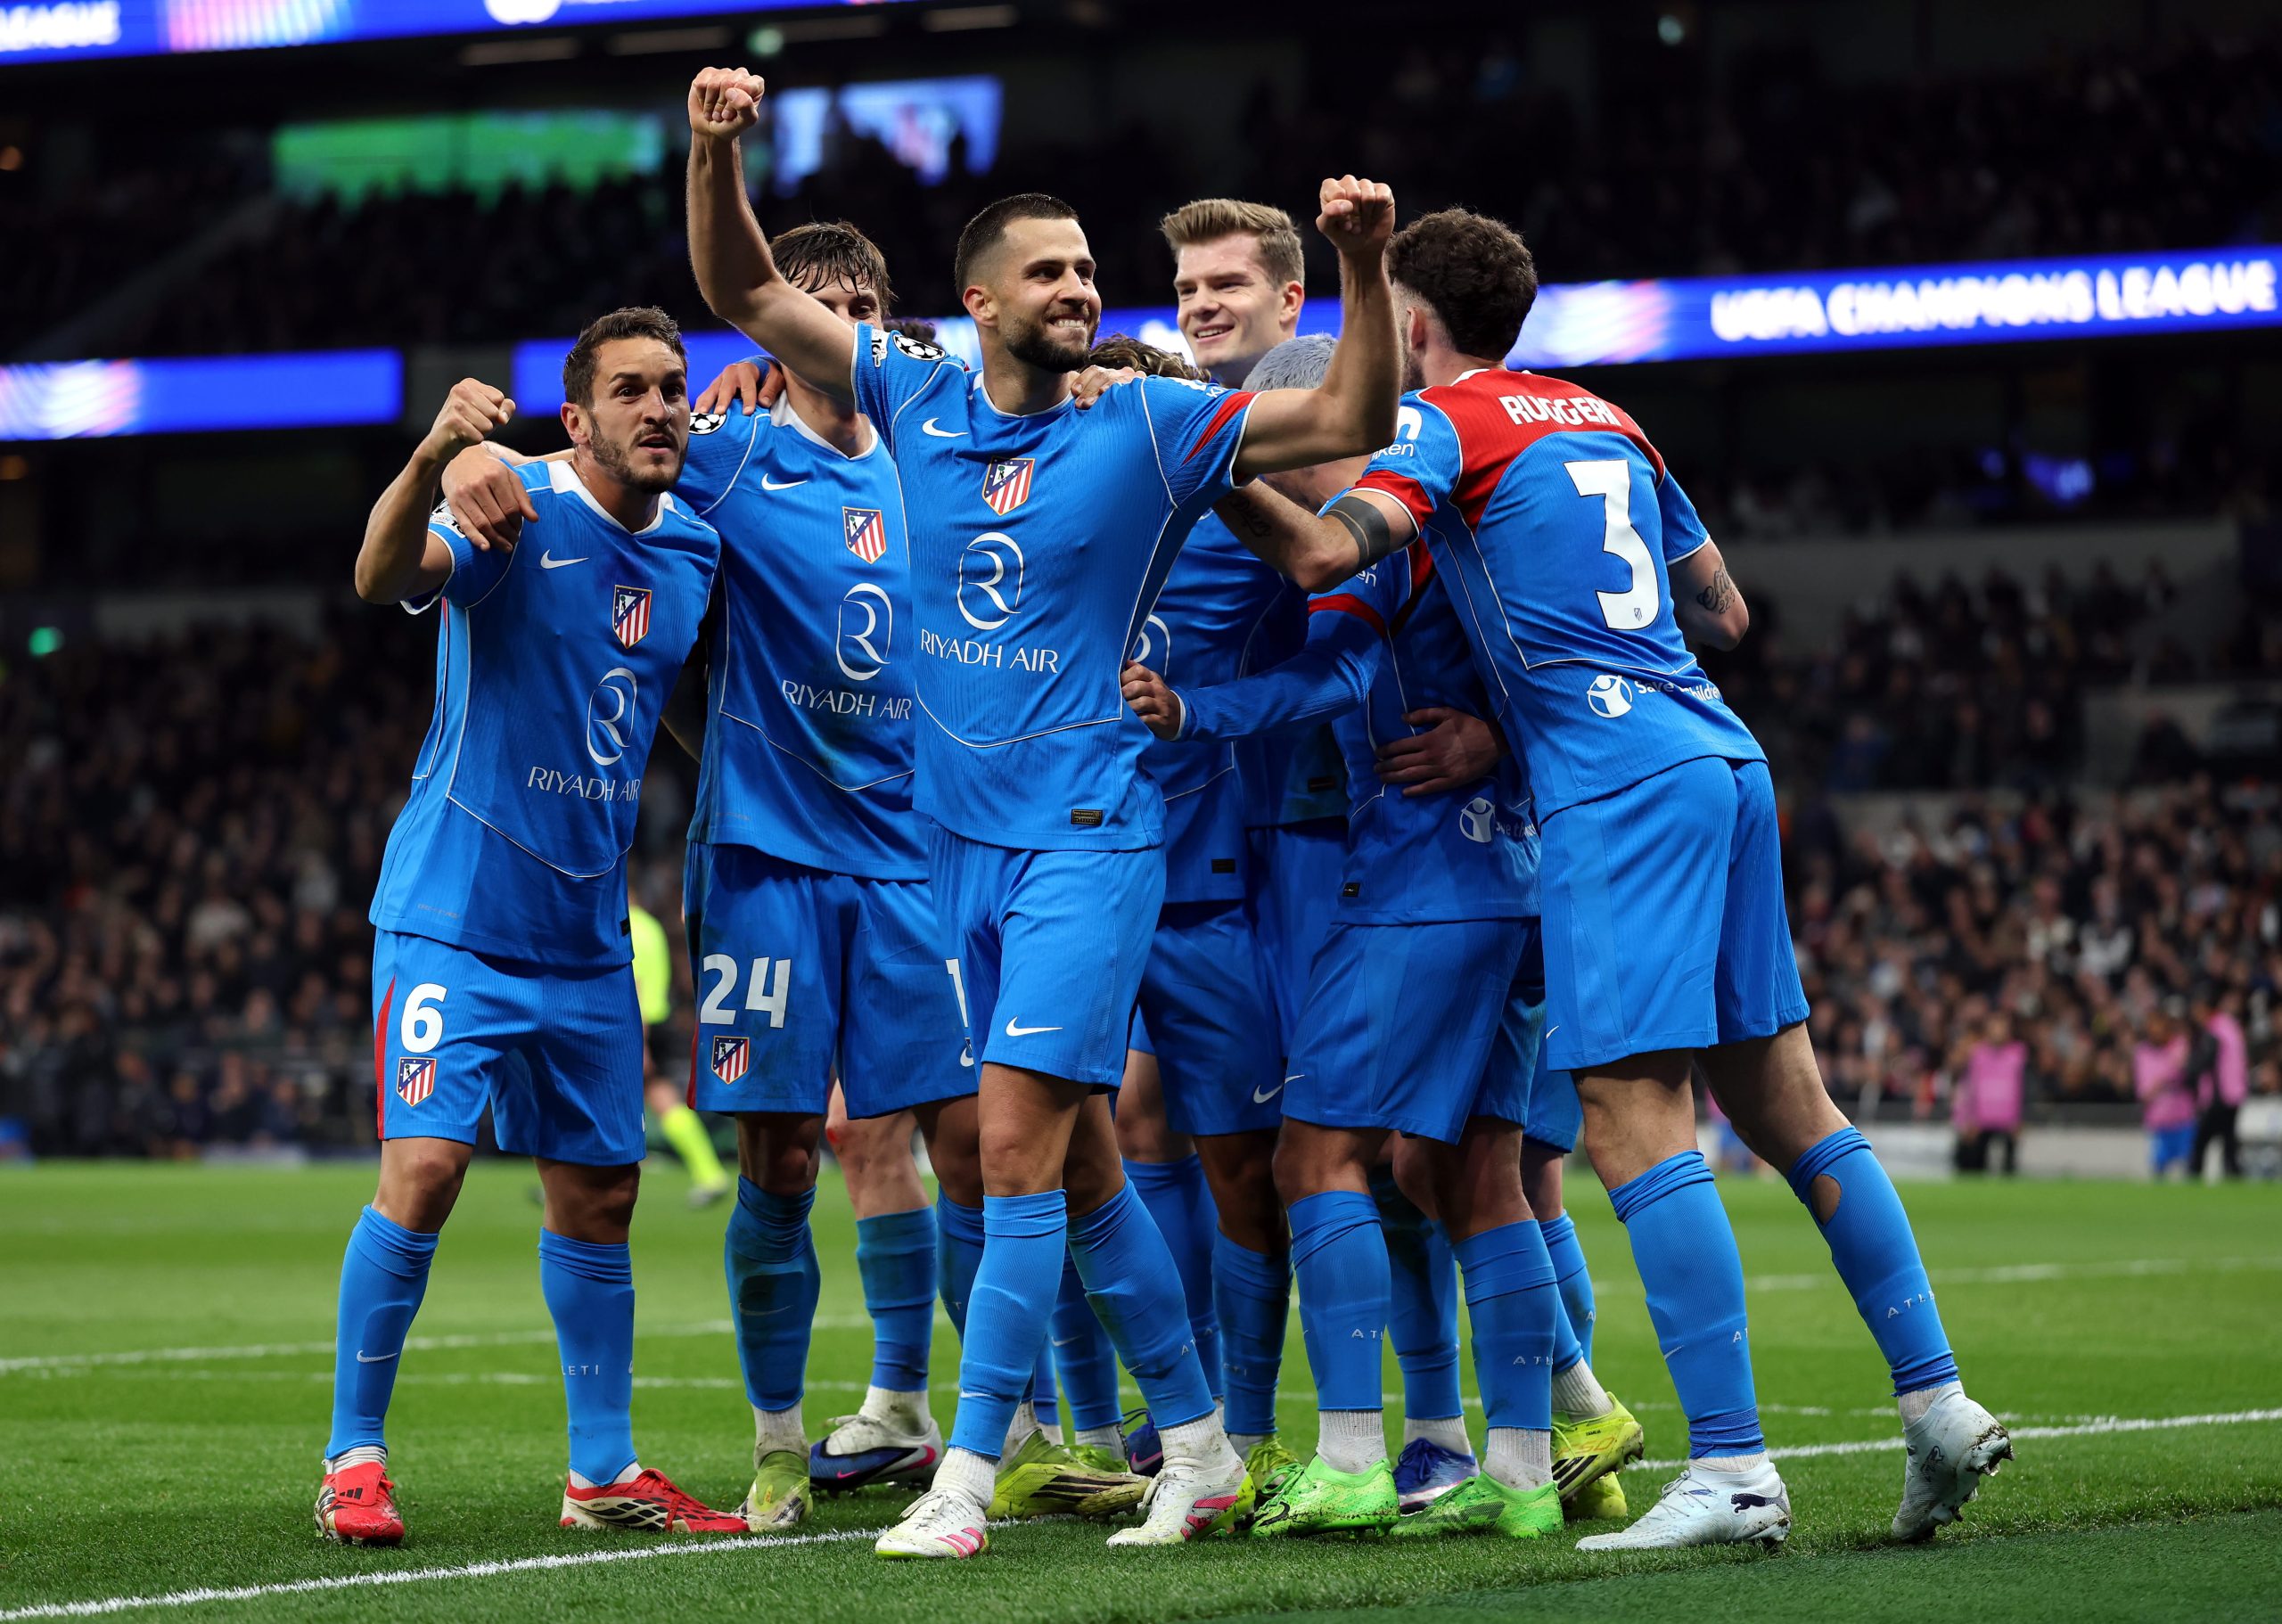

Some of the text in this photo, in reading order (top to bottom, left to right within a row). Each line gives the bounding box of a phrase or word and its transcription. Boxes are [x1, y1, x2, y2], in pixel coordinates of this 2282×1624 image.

[1711, 259, 2278, 342] UEFA CHAMPIONS LEAGUE
[1564, 459, 1660, 630] 3
[921, 628, 1059, 674] RIYADH AIR
[782, 679, 912, 720] RIYADH AIR
[528, 766, 641, 801] RIYADH AIR
[400, 982, 447, 1054] 6
[701, 953, 792, 1029] 24
